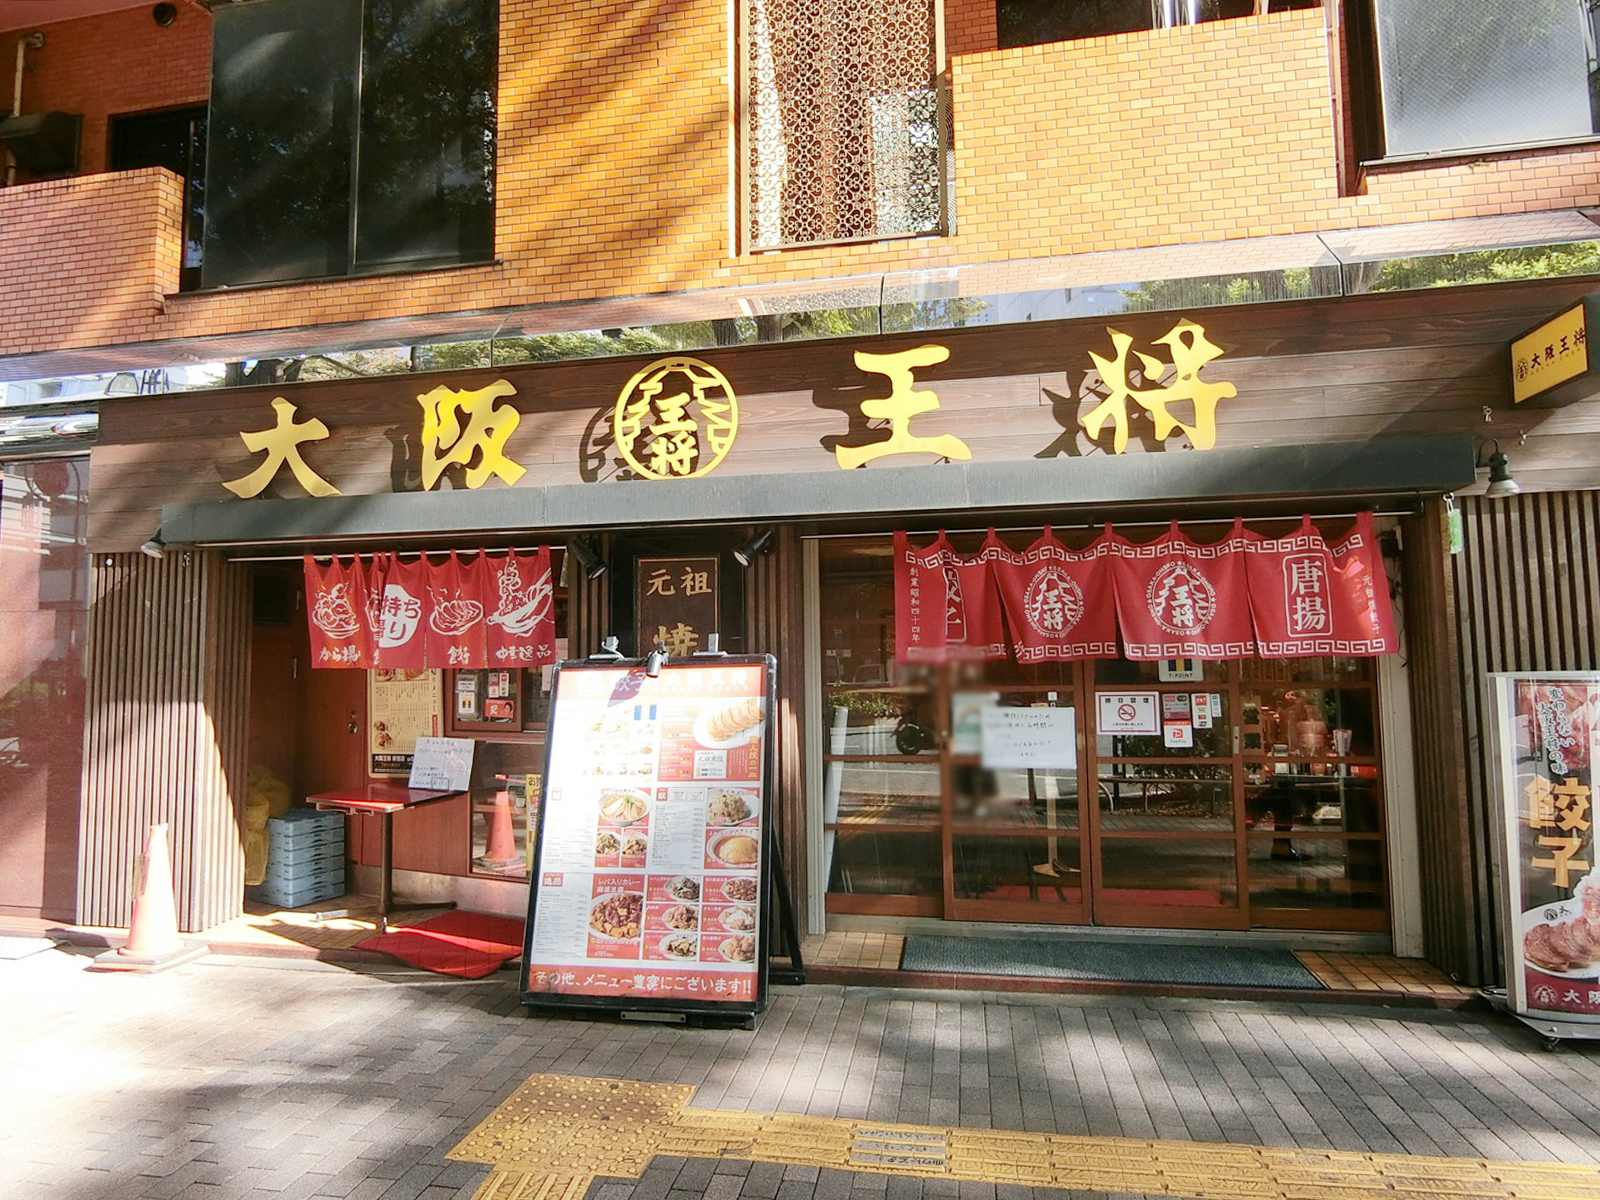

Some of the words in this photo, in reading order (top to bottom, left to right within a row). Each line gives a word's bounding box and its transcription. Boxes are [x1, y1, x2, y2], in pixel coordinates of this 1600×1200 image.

[1530, 327, 1585, 369] 大阪王将
[649, 392, 698, 476] 王将
[646, 567, 712, 596] 元祖
[1042, 589, 1064, 630] 王将
[1169, 585, 1194, 627] 王将
[1291, 559, 1326, 631] 唐揚
[1537, 702, 1568, 775] 大阪王将の味
[1549, 688, 1575, 748] 変わらない
[1524, 778, 1592, 888] 餃子
